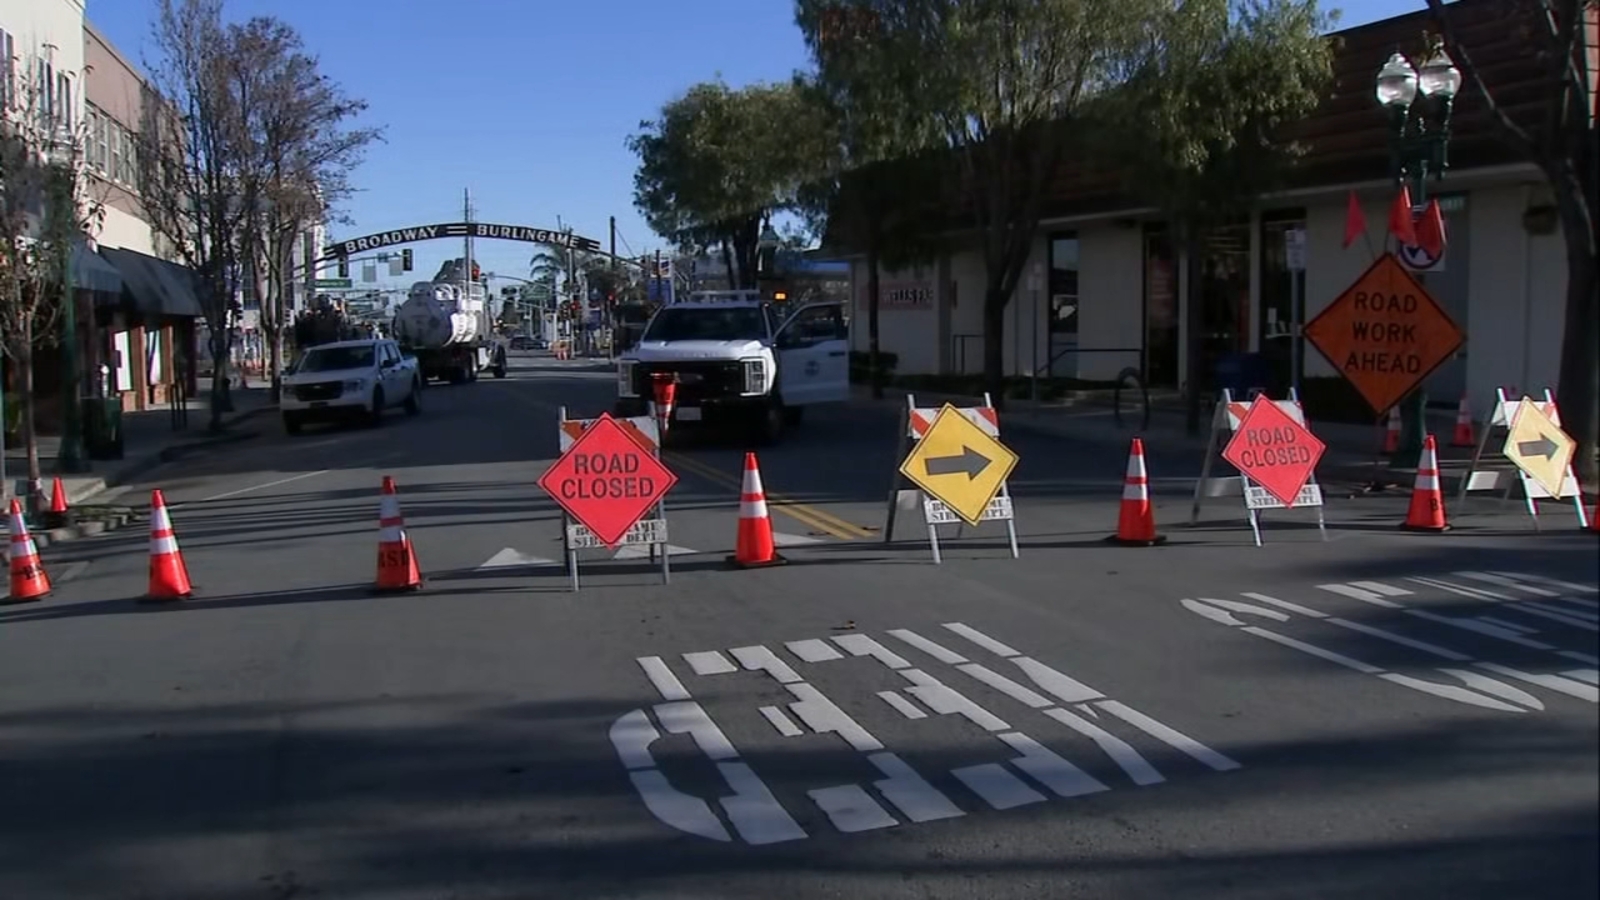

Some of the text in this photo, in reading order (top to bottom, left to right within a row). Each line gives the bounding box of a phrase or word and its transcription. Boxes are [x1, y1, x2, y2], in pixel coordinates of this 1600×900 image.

[344, 224, 580, 253] BROADWAY BURLINGAME
[1354, 291, 1418, 313] ROAD
[1352, 322, 1416, 343] WORK
[1344, 353, 1421, 374] AHEAD
[1247, 426, 1296, 447] ROAD
[574, 453, 639, 474] ROAD
[1241, 446, 1311, 468] CLOSED
[561, 477, 655, 499] CLOSED
